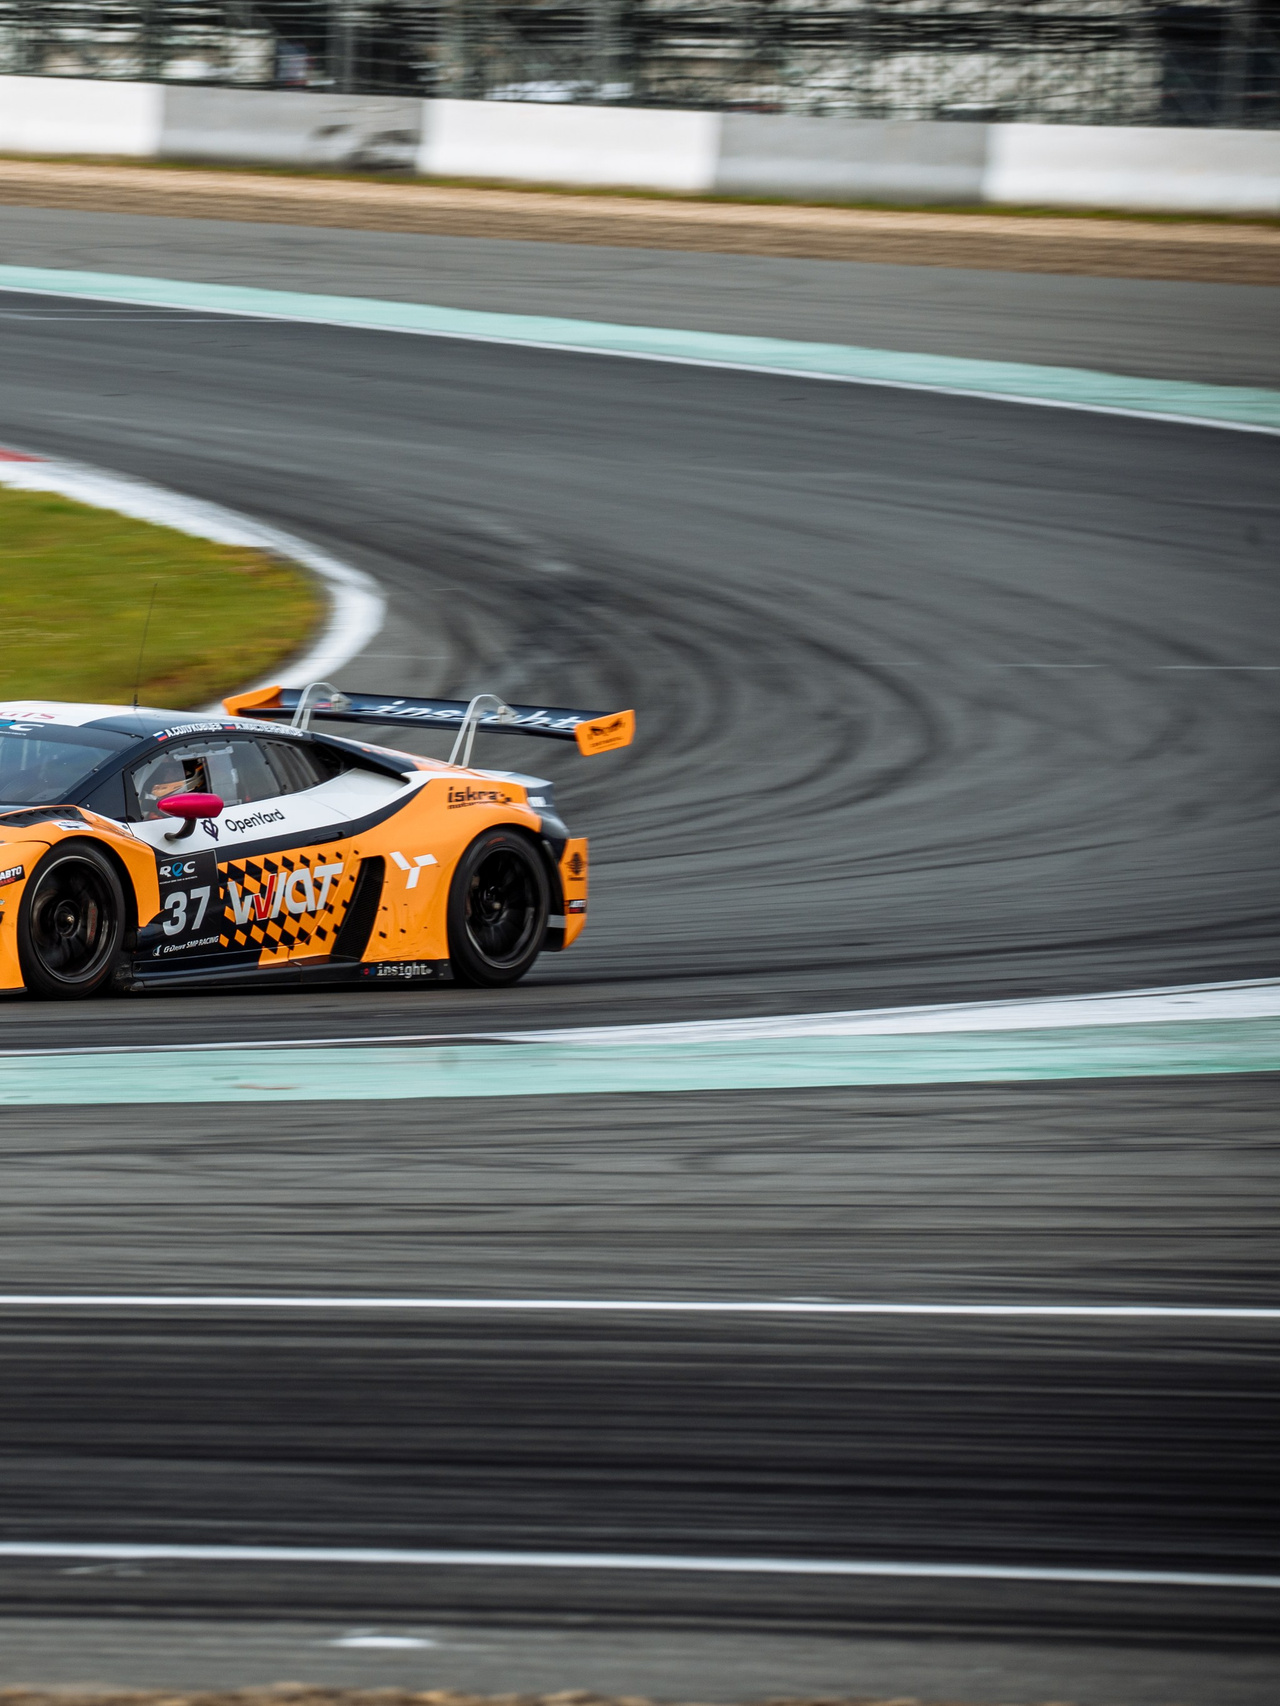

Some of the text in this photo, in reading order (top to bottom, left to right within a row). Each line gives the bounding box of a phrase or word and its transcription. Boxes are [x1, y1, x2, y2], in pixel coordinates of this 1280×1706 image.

[448, 786, 500, 803] iskra
[224, 808, 286, 835] OpenYard
[162, 885, 211, 936] 37
[198, 935, 219, 947] RACING
[376, 963, 428, 979] insight
